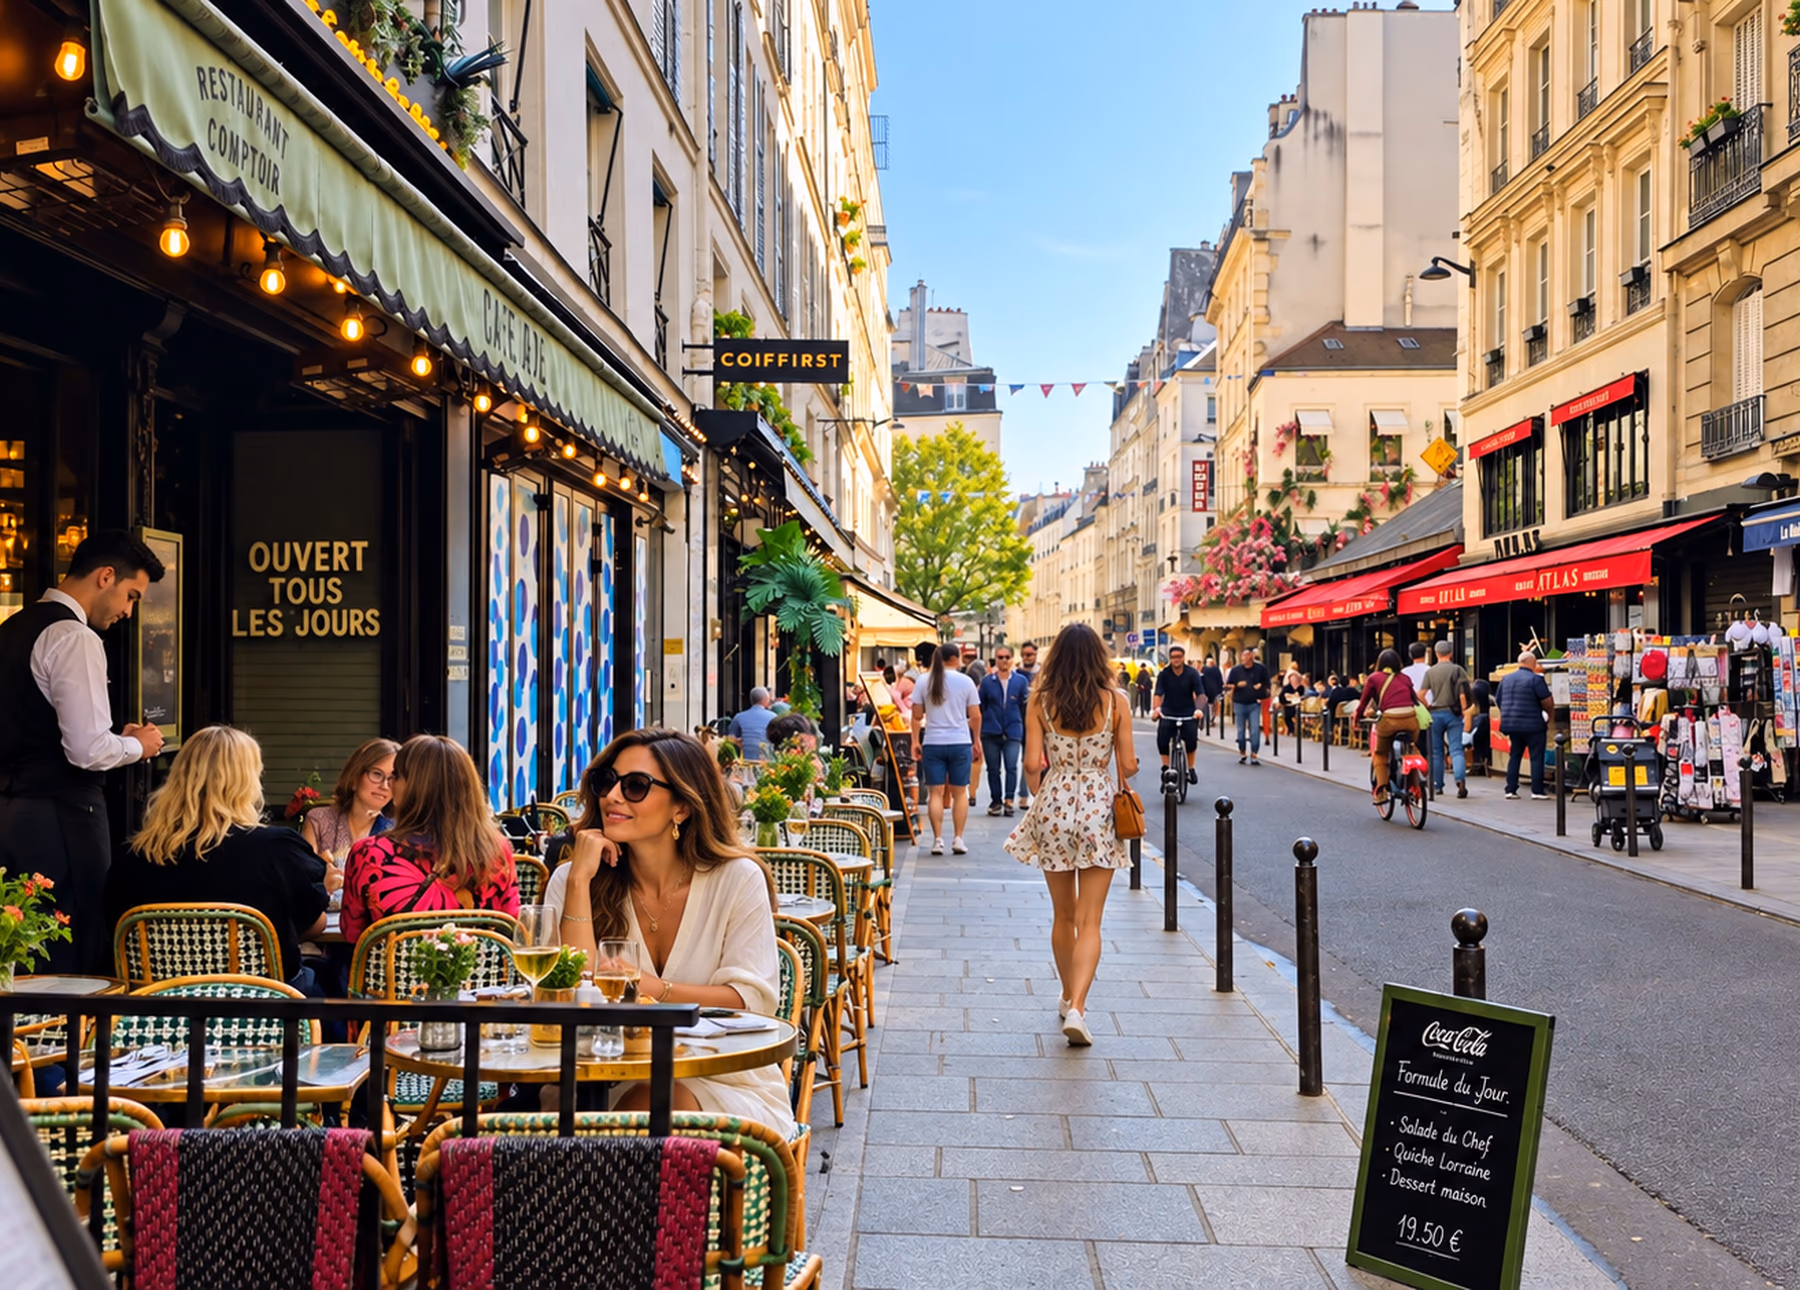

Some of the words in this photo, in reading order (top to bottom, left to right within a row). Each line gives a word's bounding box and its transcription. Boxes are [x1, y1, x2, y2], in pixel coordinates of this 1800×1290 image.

[196, 65, 290, 160] RESTAURANT
[207, 117, 281, 196] COMPTOIR
[720, 351, 843, 368] COIFFIRST
[248, 540, 369, 573] OUVERT
[268, 576, 344, 605] TOUS
[1536, 567, 1579, 592] ATLAS
[231, 608, 285, 638] LES
[294, 608, 381, 638] JOURS
[1397, 1060, 1449, 1091] Formule
[1453, 1071, 1472, 1096] du
[1442, 1125, 1458, 1145] du
[1461, 1129, 1494, 1160] Chef
[1393, 1141, 1435, 1166] Quiche
[1438, 1152, 1492, 1181] Lorraine
[1389, 1167, 1436, 1195] Dessert
[1440, 1187, 1487, 1209] maison
[1397, 1213, 1445, 1248] 19.50
[1448, 1228, 1464, 1253] €
